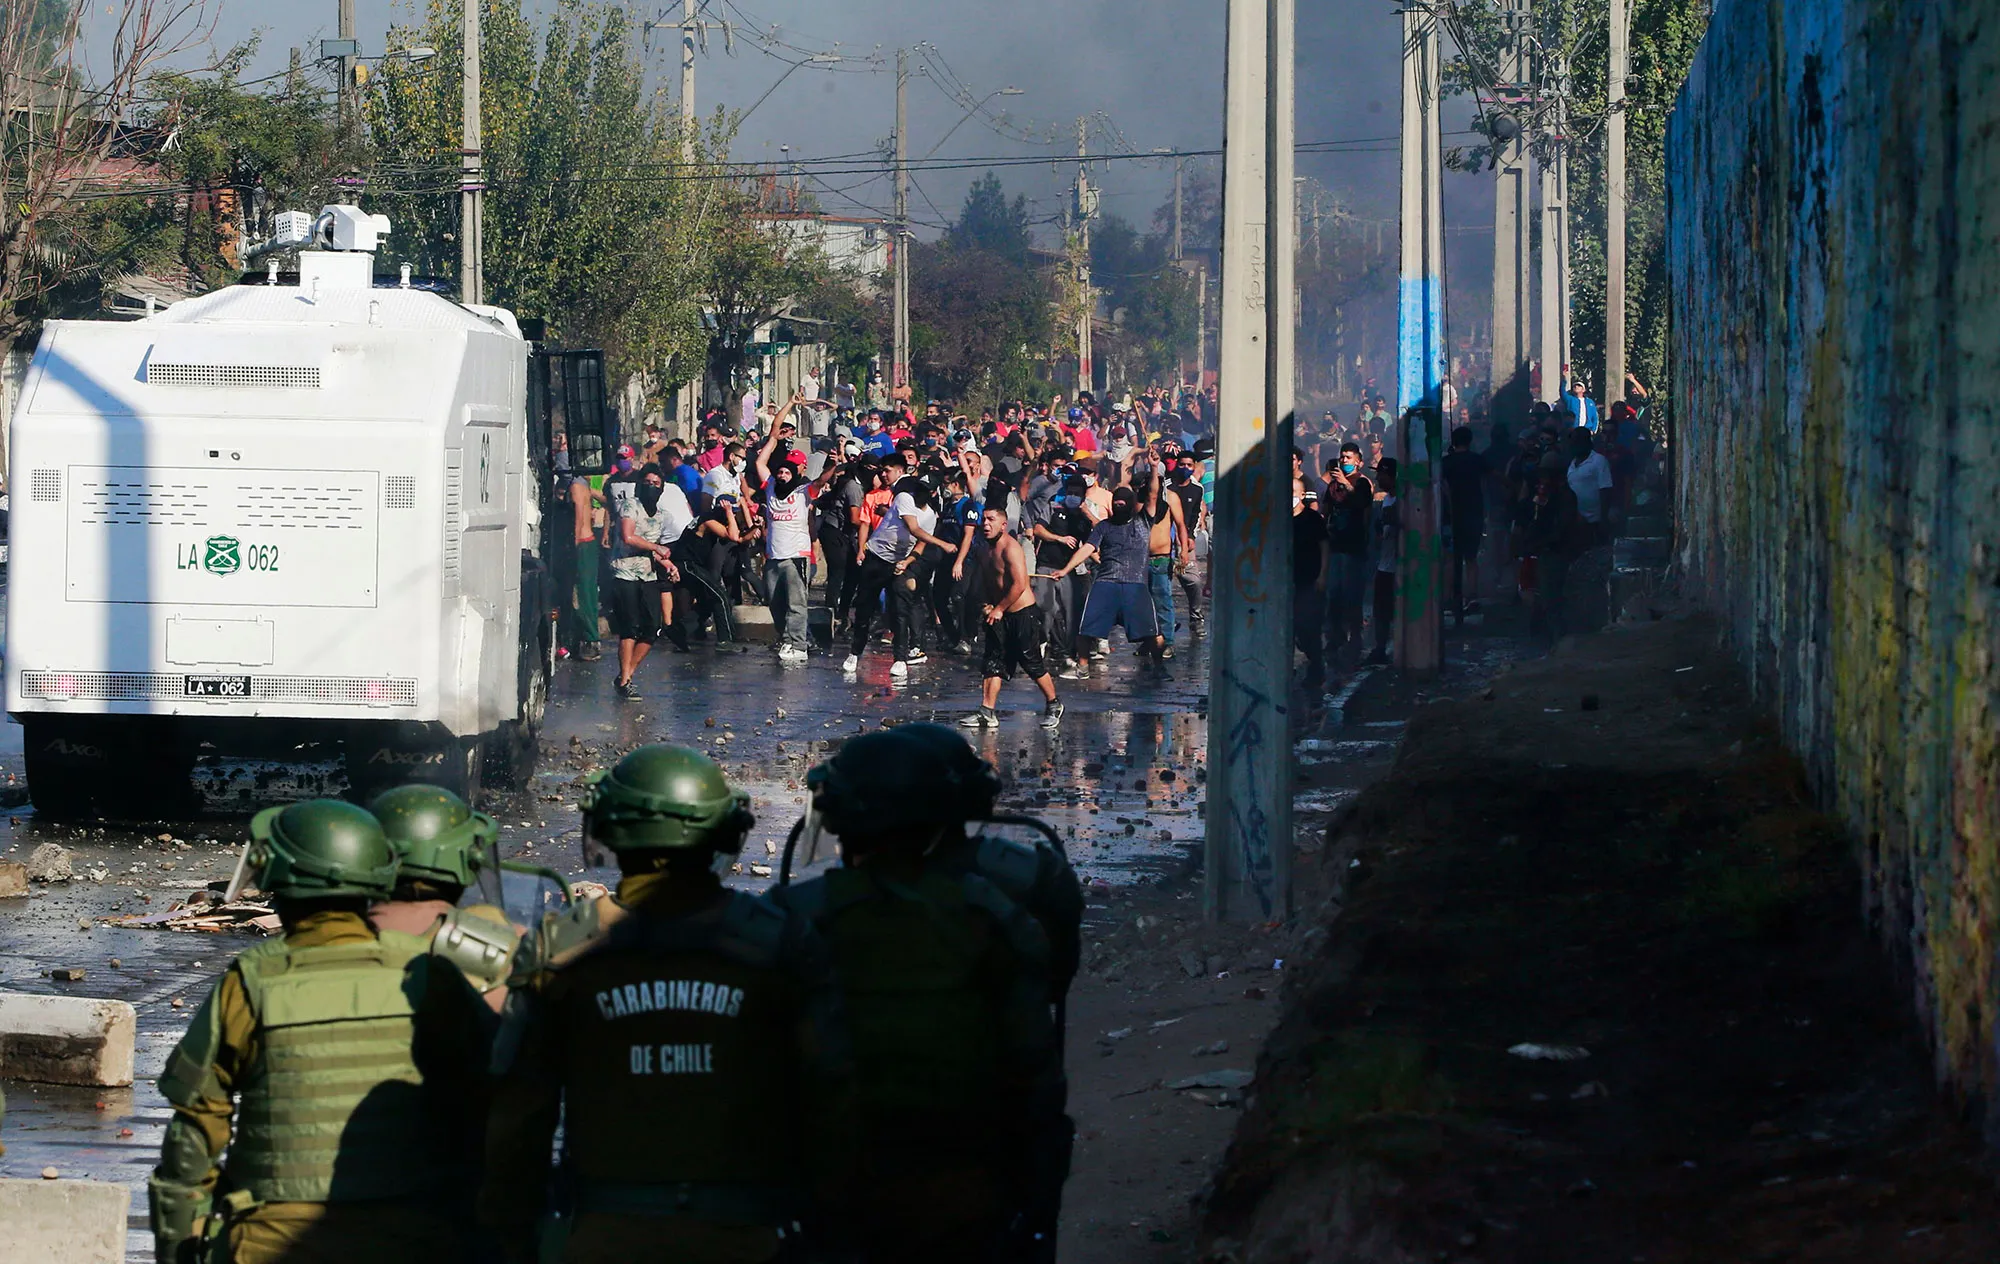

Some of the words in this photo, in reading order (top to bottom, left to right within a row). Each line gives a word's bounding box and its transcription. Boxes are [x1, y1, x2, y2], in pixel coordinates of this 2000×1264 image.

[177, 543, 198, 570] LA
[248, 544, 279, 571] 062
[188, 681, 205, 694] LA
[219, 682, 245, 695] 062
[596, 980, 745, 1020] CARABINEROS
[630, 1045, 653, 1074] DE
[660, 1044, 713, 1073] CHILE
